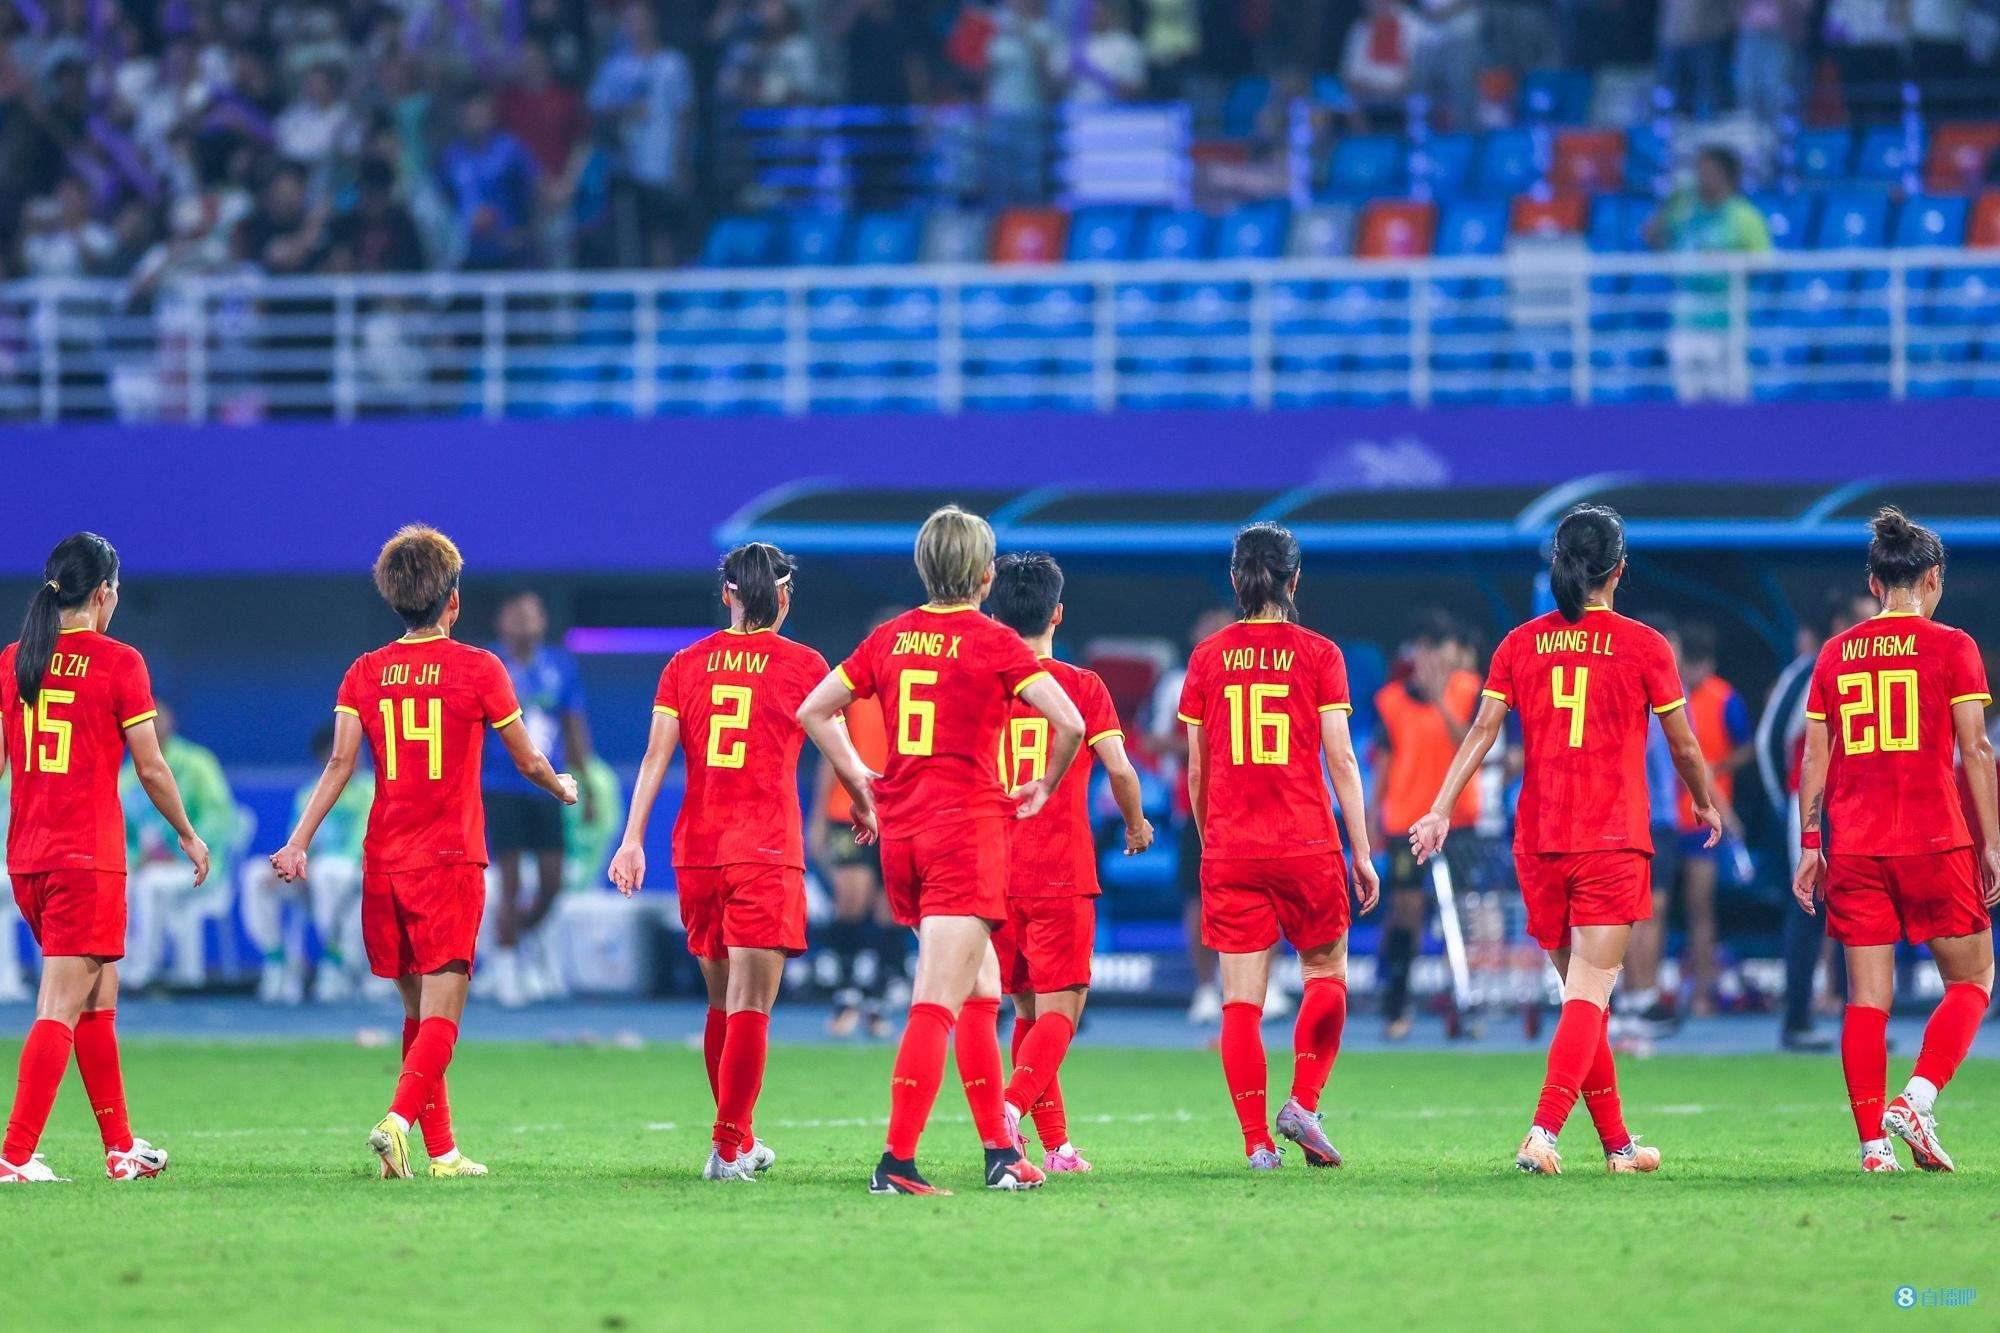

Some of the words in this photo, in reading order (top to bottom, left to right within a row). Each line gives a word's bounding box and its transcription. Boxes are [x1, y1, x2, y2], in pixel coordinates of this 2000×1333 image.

[381, 664, 410, 687] LOU
[415, 663, 441, 686] JH
[891, 630, 945, 657] ZHANG
[945, 635, 962, 659] X
[1222, 646, 1255, 671] YAO
[1536, 630, 1588, 654] WANG
[1842, 638, 1869, 662] WU
[1872, 634, 1919, 657] RGML
[19, 688, 76, 774] 15
[379, 697, 442, 780] 14
[706, 684, 753, 769] 2
[897, 668, 939, 757] 6
[1223, 683, 1290, 766] 16
[1551, 665, 1589, 749] 4
[1837, 669, 1920, 757] 20
[1236, 1089, 1265, 1101] CFA
